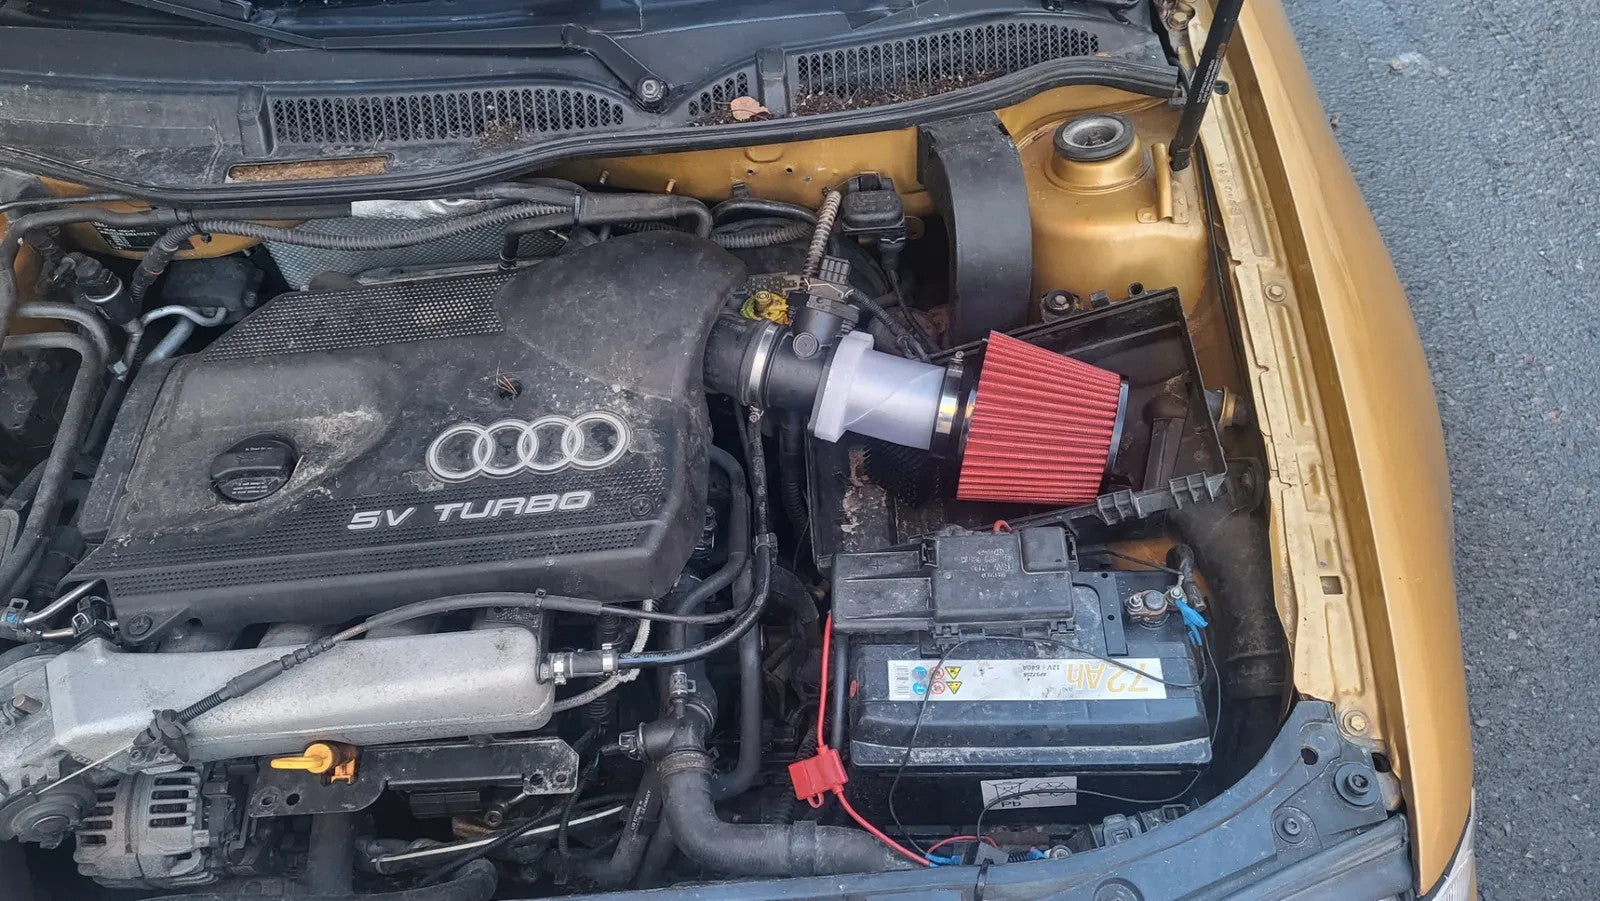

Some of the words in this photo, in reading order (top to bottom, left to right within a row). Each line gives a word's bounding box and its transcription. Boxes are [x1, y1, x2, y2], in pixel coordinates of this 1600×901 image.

[346, 506, 417, 530] 5V
[434, 490, 594, 522] TURBO
[1066, 663, 1149, 693] 72Ah
[1001, 800, 1022, 808] Pb
